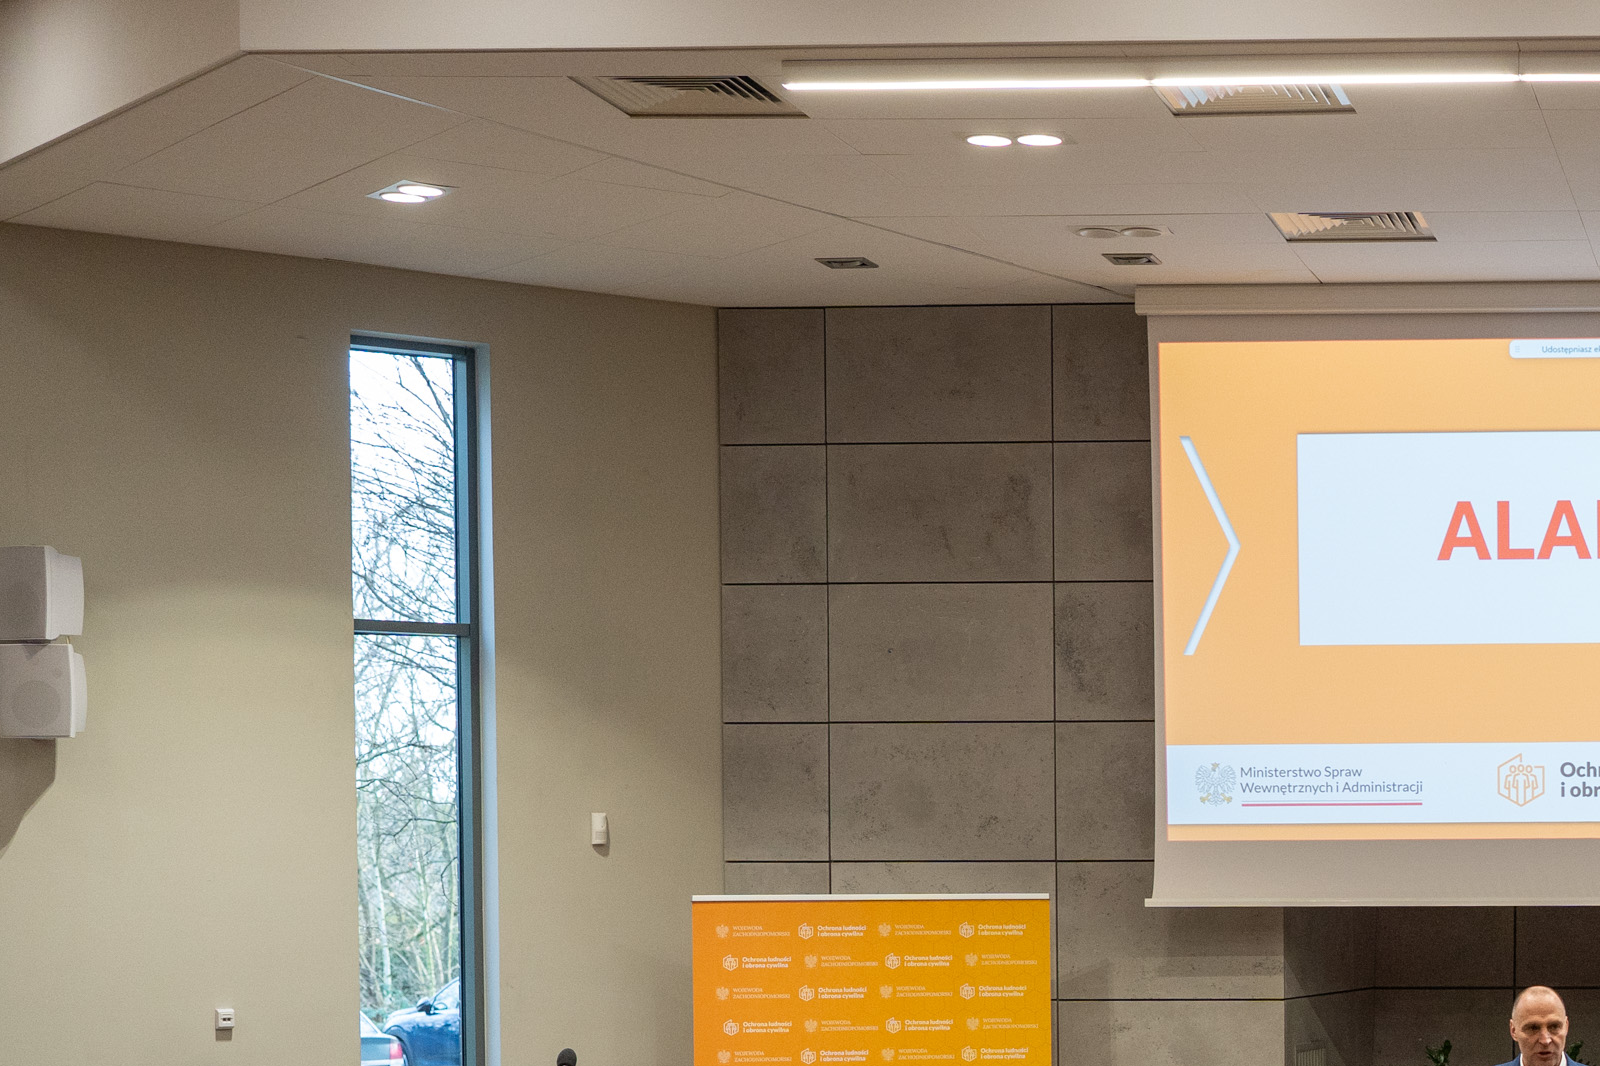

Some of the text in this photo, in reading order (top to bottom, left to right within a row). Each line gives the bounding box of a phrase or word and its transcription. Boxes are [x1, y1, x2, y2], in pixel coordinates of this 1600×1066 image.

[1542, 346, 1592, 354] Udostępniasz
[1240, 766, 1362, 779] Ministerstwo Spraw
[1240, 781, 1423, 795] Wewnętrznych i Administracji
[1560, 782, 1566, 797] i
